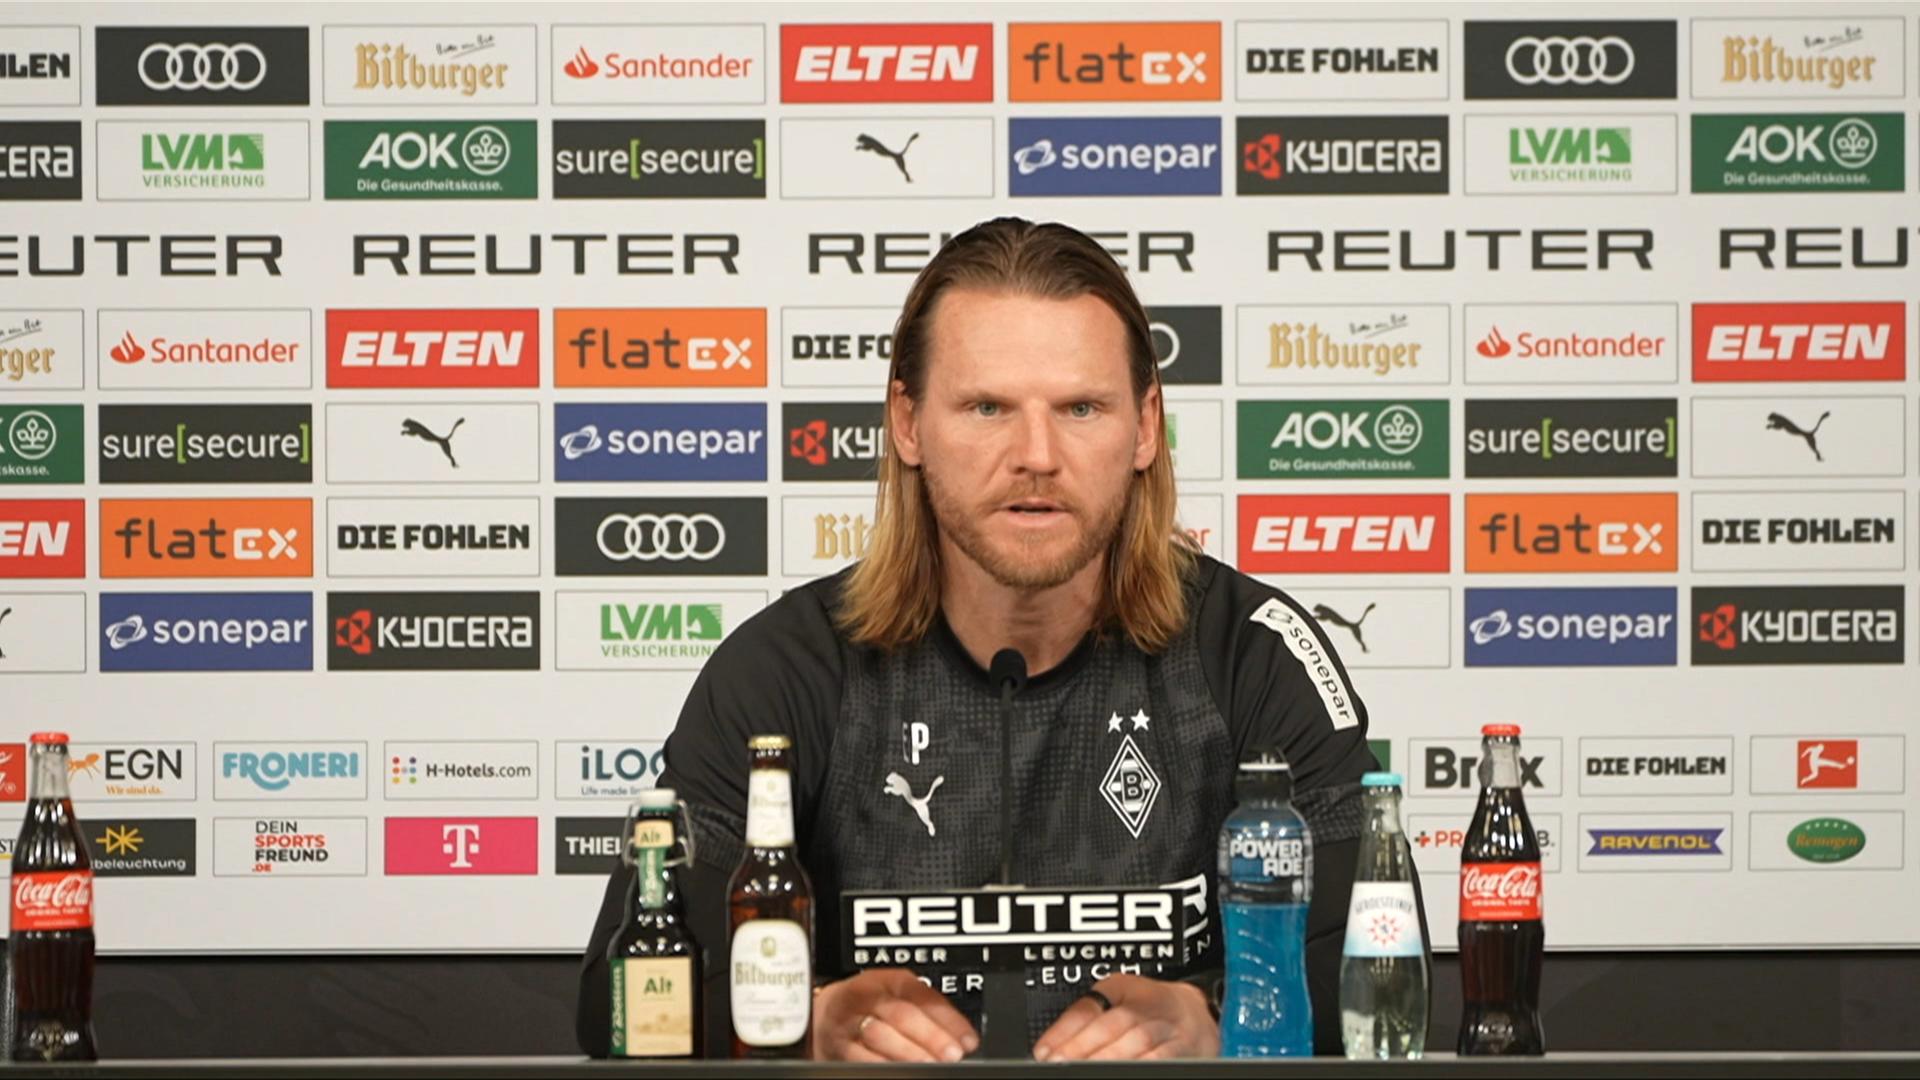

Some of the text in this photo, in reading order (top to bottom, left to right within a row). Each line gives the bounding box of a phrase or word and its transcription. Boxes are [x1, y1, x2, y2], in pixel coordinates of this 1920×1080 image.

[355, 44, 506, 96] Bitburger
[605, 53, 752, 78] Santander
[795, 46, 978, 81] ELTEN
[1246, 48, 1438, 73] DIE FOHLEN
[1723, 36, 1875, 89] Bitburger
[142, 134, 223, 170] LVM
[359, 132, 458, 169] AOK
[1510, 128, 1591, 164] LVM
[1726, 125, 1825, 163] AOK
[1062, 144, 1216, 173] sonepar
[143, 175, 264, 187] VERSICHERUNG
[357, 179, 502, 191] Die Gesundheitskasse.
[1510, 168, 1632, 181] VERSICHERUNG
[1724, 172, 1869, 185] Die Gesundheitskasse.
[353, 234, 739, 276] REUTER
[1268, 229, 1653, 271] REUTER
[1720, 227, 1920, 269] REU
[151, 338, 298, 363] Santander
[342, 331, 524, 366] ELTEN
[792, 335, 851, 359] DIE
[1269, 323, 1421, 376] Bitburger
[1518, 333, 1664, 357] Santander
[1707, 324, 1890, 360] ELTEN
[608, 430, 762, 459] sonepar
[1271, 412, 1370, 449] AOK
[1269, 458, 1414, 471] Die Gesundheitskasse.
[338, 525, 529, 550] DIE FOHLEN
[1252, 516, 1435, 551] ELTEN
[1702, 518, 1894, 544] DIE FOHLEN
[154, 620, 307, 648] sonepar
[601, 604, 682, 640] LVM
[1518, 615, 1672, 643] sonepar
[1288, 627, 1350, 720] sonepar
[105, 749, 181, 780] EGN
[223, 752, 358, 791] FRONERI
[427, 764, 531, 777] H-Hotels.com
[1587, 757, 1725, 776] DIE FOHLEN
[256, 821, 297, 833] DEIN
[255, 835, 325, 848] SPORTS
[256, 849, 328, 862] FREUND
[1229, 838, 1303, 859] POWER
[1600, 835, 1711, 849] RAVENOL
[1263, 858, 1303, 877] ADE
[853, 893, 1174, 935] REUTER
[1023, 943, 1175, 962] LEUCHTEN
[643, 976, 674, 996] Alt
